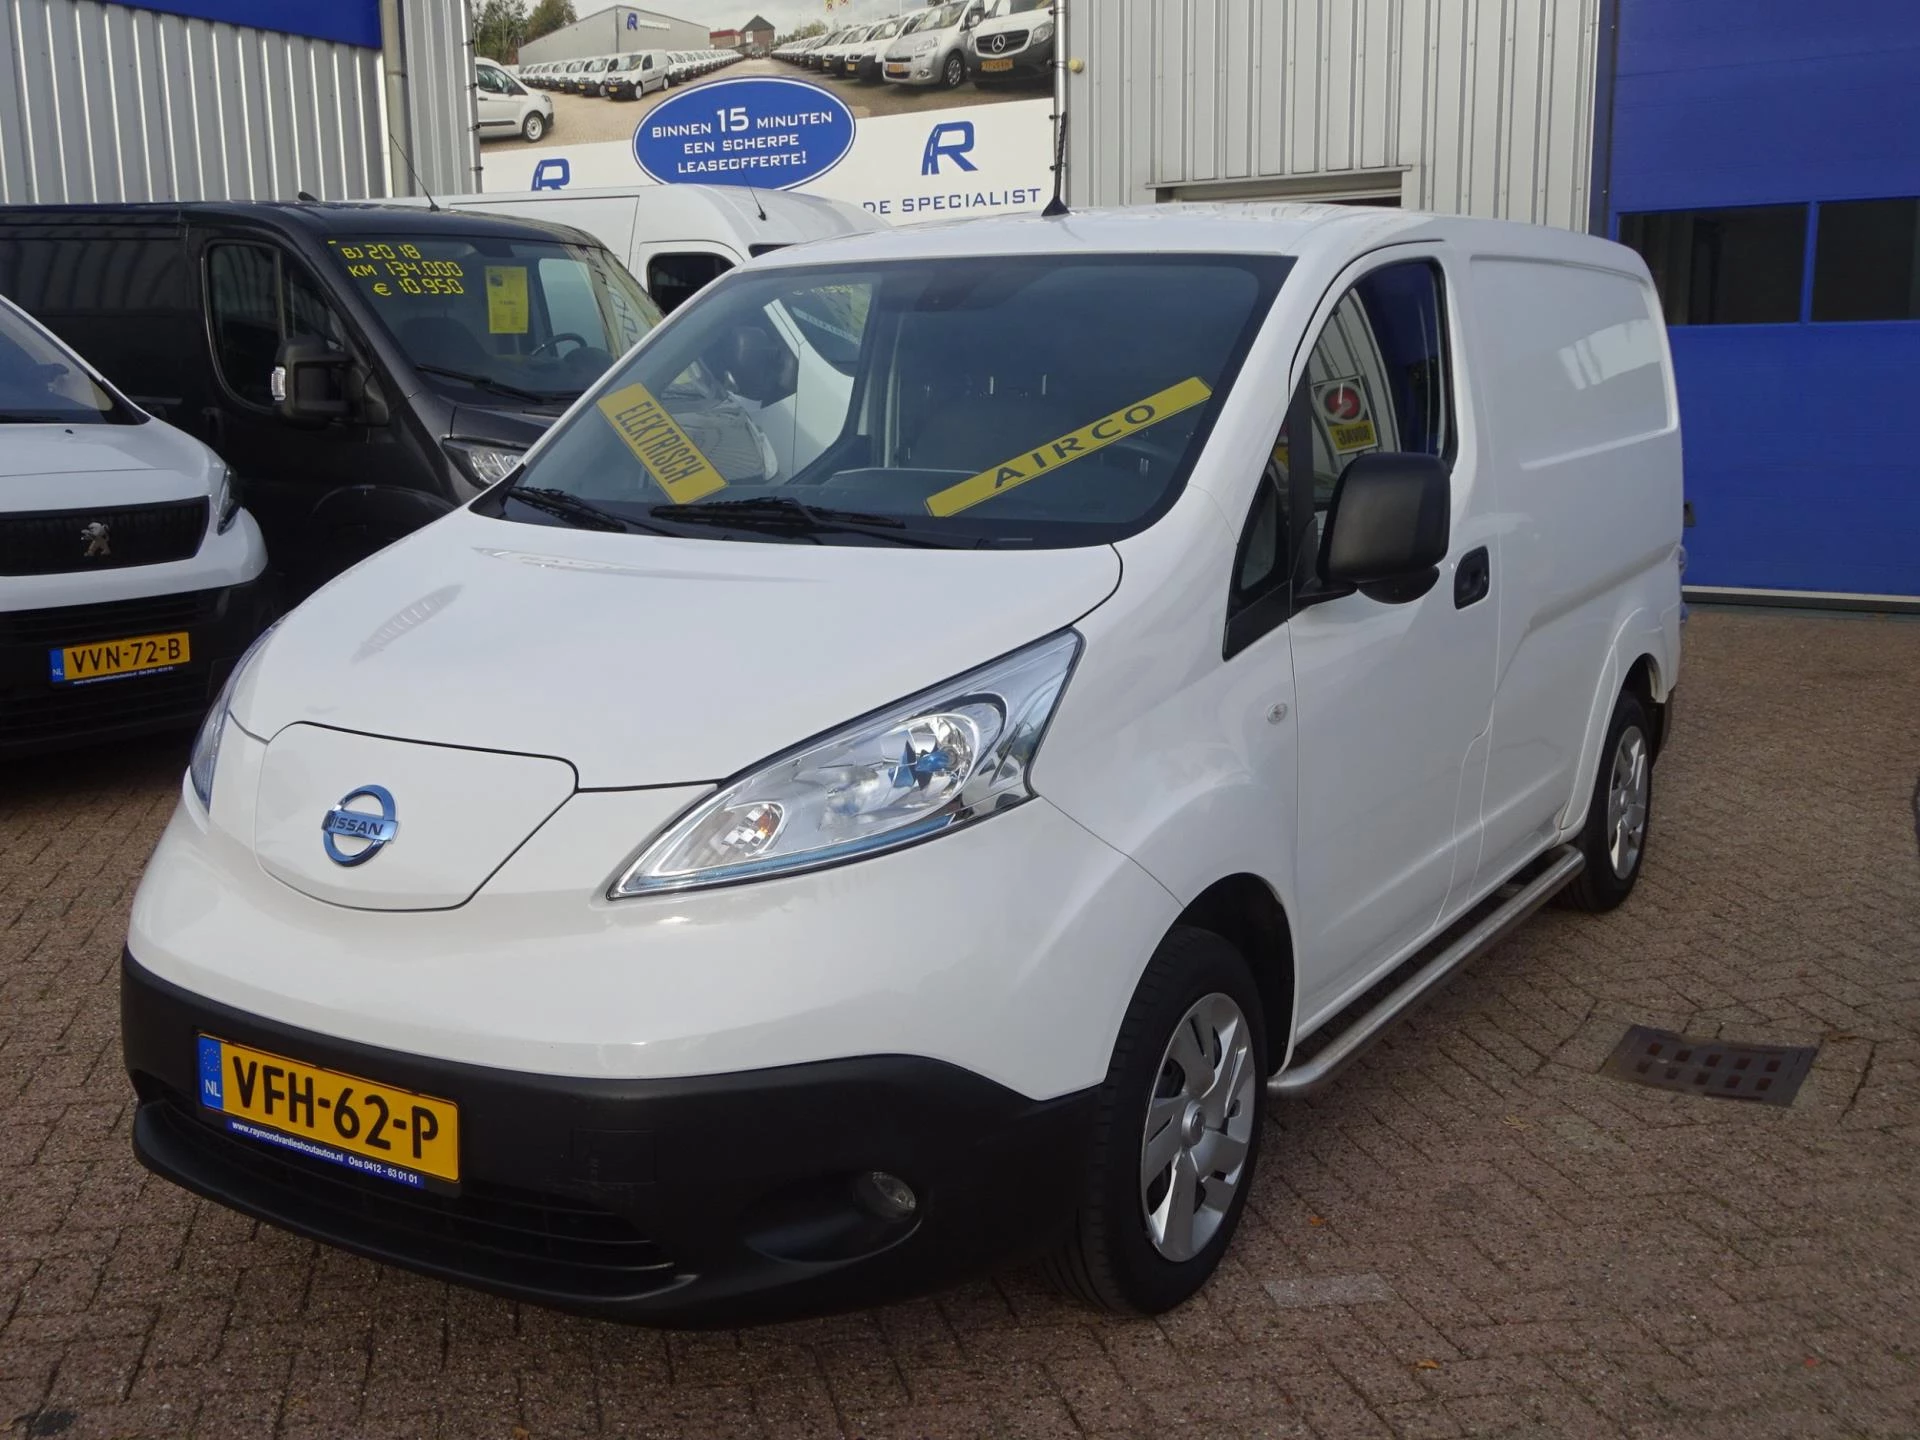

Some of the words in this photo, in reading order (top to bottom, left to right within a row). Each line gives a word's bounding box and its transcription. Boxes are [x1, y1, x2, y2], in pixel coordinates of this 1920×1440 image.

[652, 123, 712, 138] BINNEN
[717, 107, 750, 132] 15
[756, 111, 833, 129] MINUTEN
[684, 142, 715, 154] EEN
[722, 134, 800, 151] SCHERPE
[677, 151, 807, 173] LEASEOFFERTE!
[863, 200, 891, 214] DE
[902, 188, 1041, 212] SPECIALIST
[365, 244, 422, 260] 2018
[348, 264, 378, 278] KM
[384, 261, 465, 278] 134.000
[398, 278, 465, 295] 10.950
[614, 400, 706, 485] ELEKTRISCH
[994, 404, 1156, 489] AIRCO
[72, 638, 181, 673] VVN-72-B
[52, 668, 64, 676] NL
[204, 1079, 222, 1098] NL
[232, 1055, 439, 1159] VFH-62-P
[348, 1156, 363, 1168] Oss
[363, 1161, 382, 1173] 0412
[387, 1168, 398, 1178] 63
[398, 1171, 407, 1181] 01
[408, 1174, 418, 1184] 01
